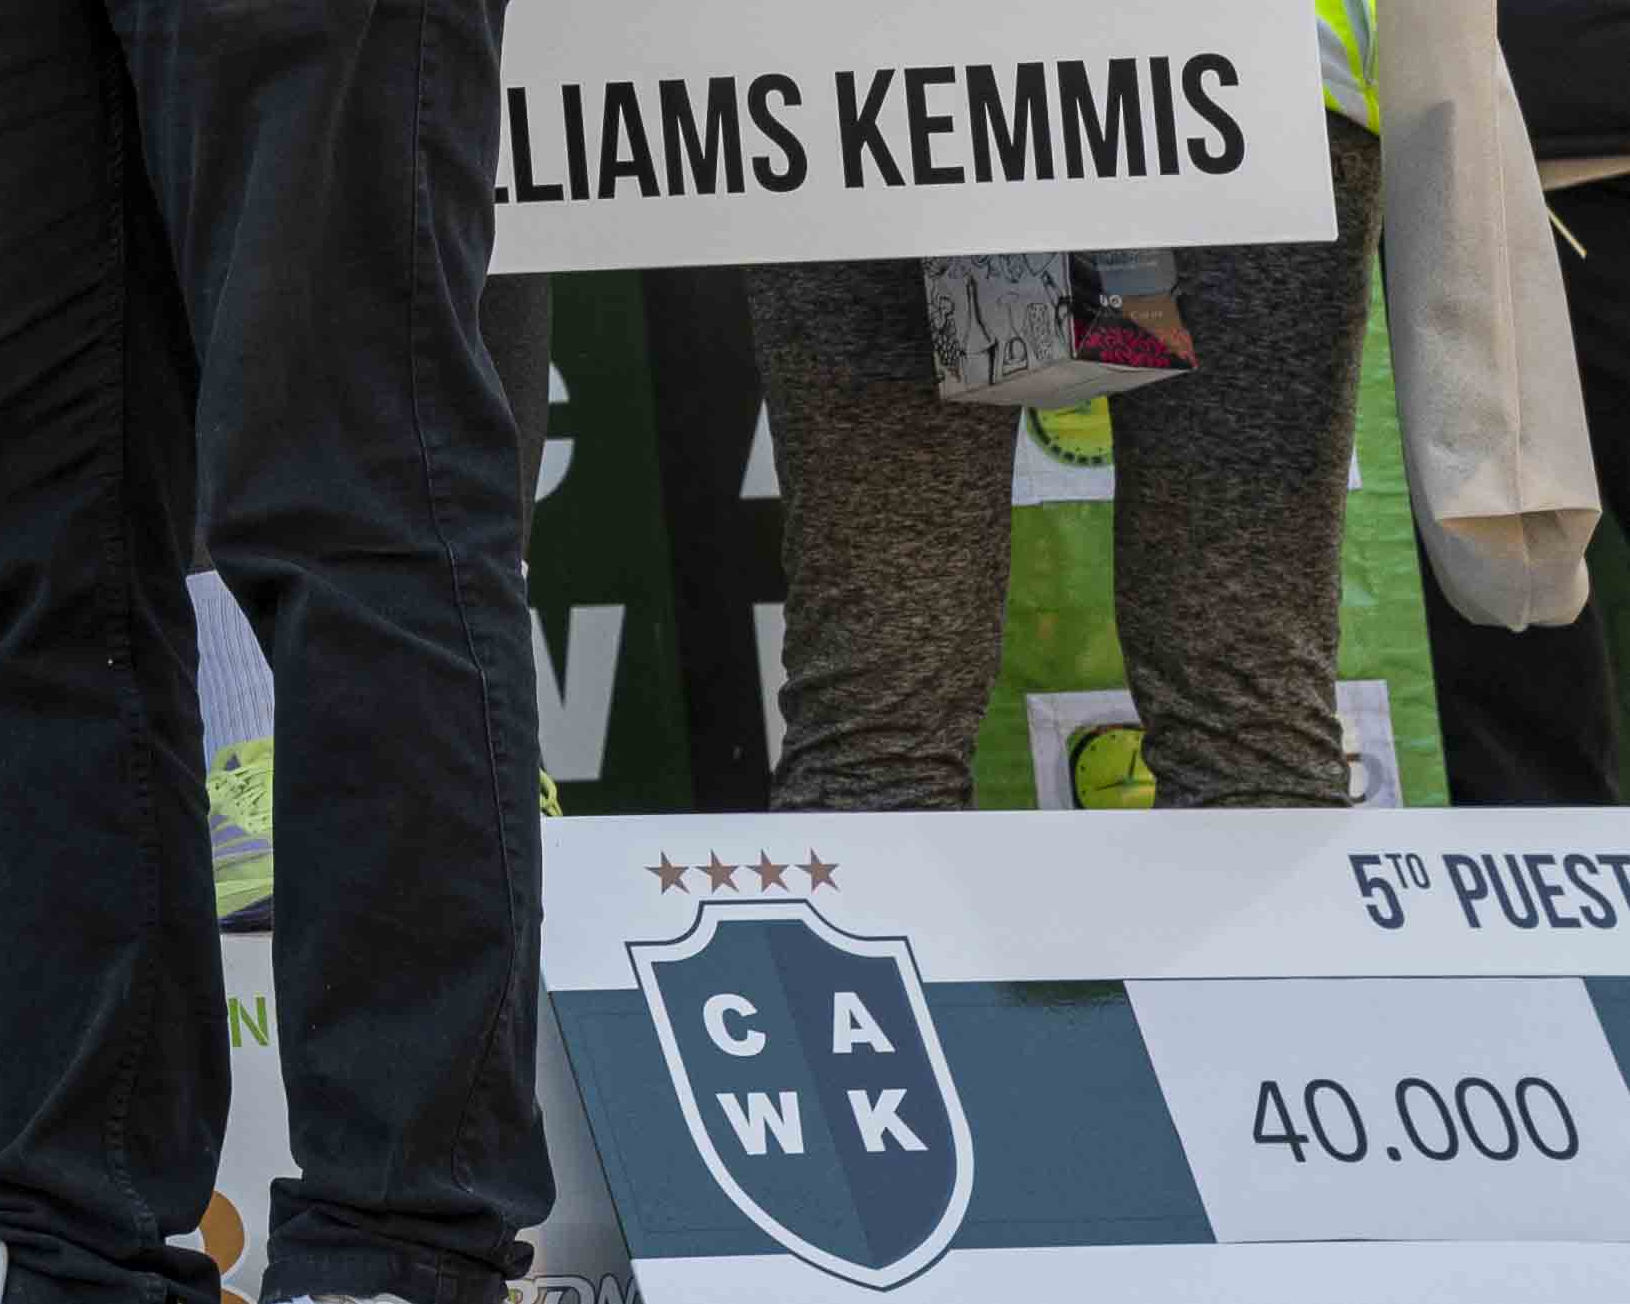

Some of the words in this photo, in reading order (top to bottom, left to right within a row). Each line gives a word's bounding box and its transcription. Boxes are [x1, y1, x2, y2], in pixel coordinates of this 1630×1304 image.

[494, 72, 807, 205] LIAMS
[836, 52, 1245, 189] KEMMIS
[1442, 854, 1630, 929] PUEST
[703, 994, 765, 1056] C
[832, 992, 895, 1054] A
[718, 1092, 805, 1157] W
[847, 1089, 928, 1152] K
[1253, 1077, 1580, 1163] 40.000
